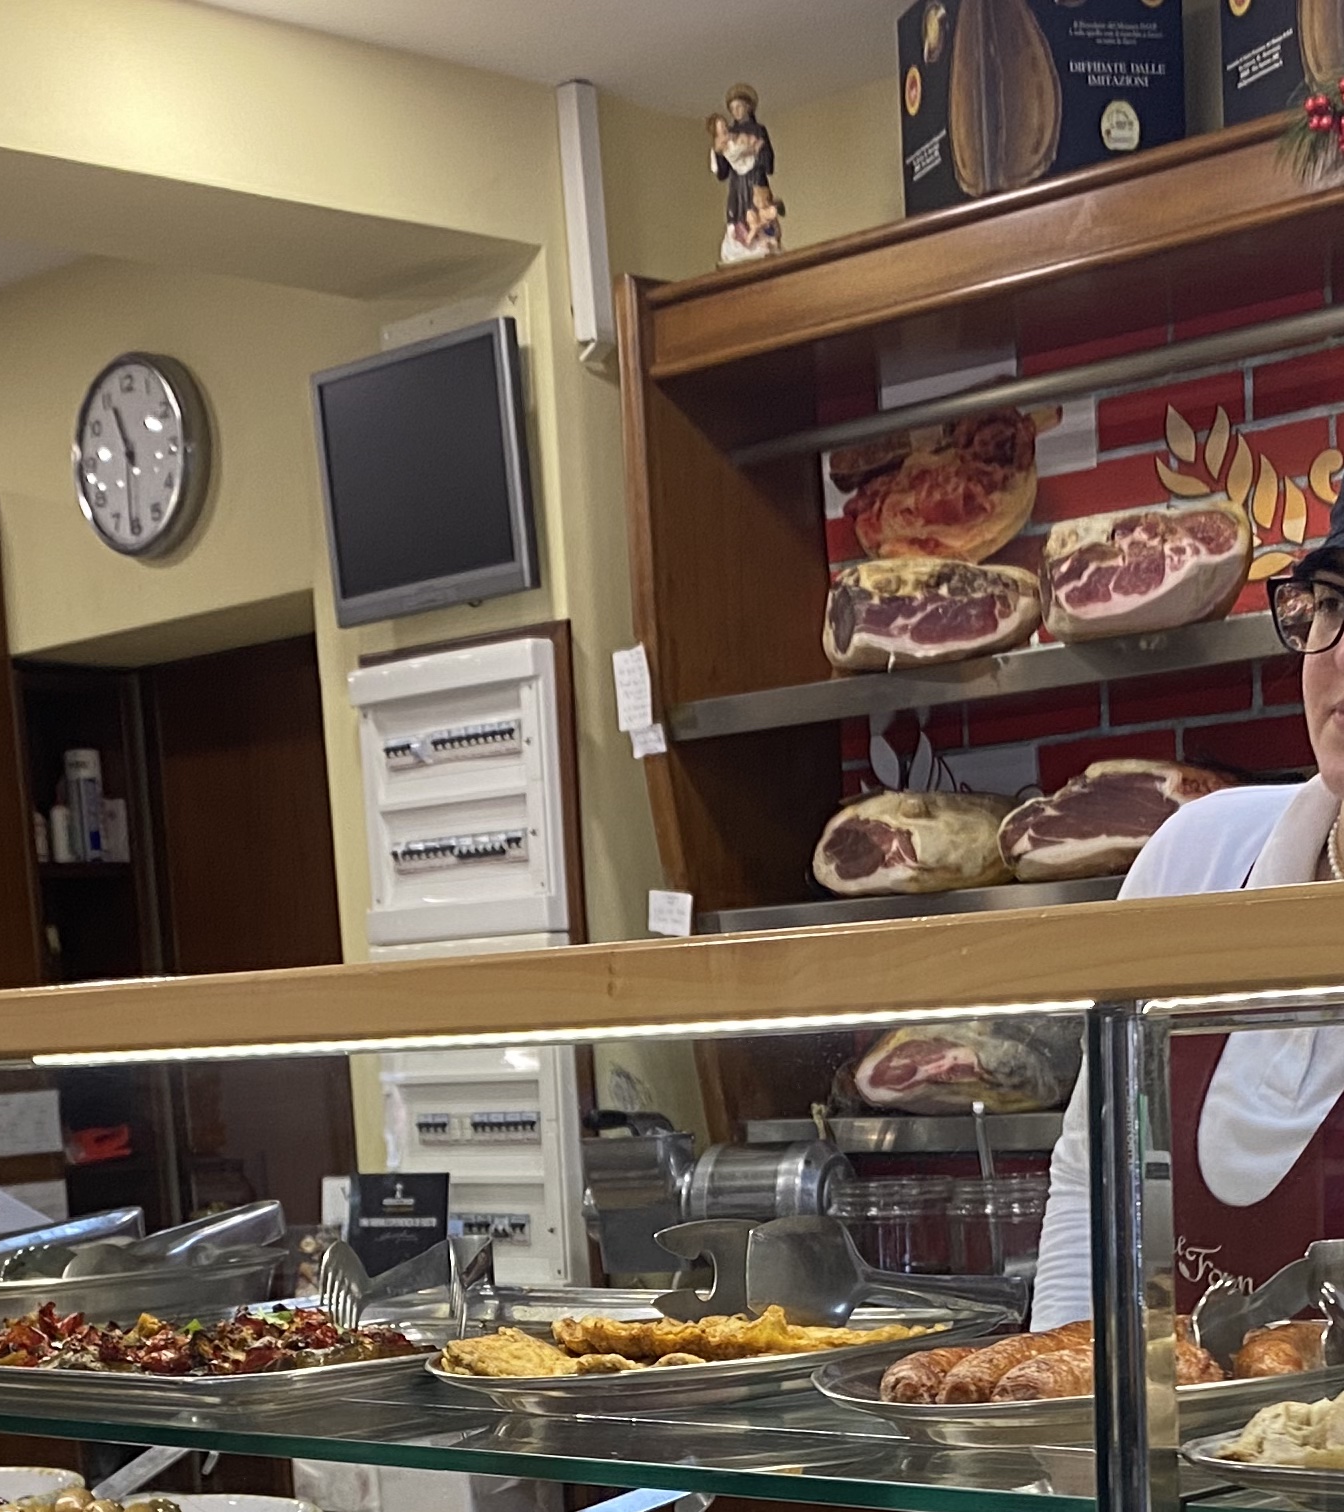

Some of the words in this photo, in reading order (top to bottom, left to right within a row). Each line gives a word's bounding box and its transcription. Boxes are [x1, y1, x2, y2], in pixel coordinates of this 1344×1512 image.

[1069, 60, 1127, 75] DIFFIDATE
[1131, 61, 1166, 75] DALLE
[1087, 74, 1149, 88] IMITAZIONI
